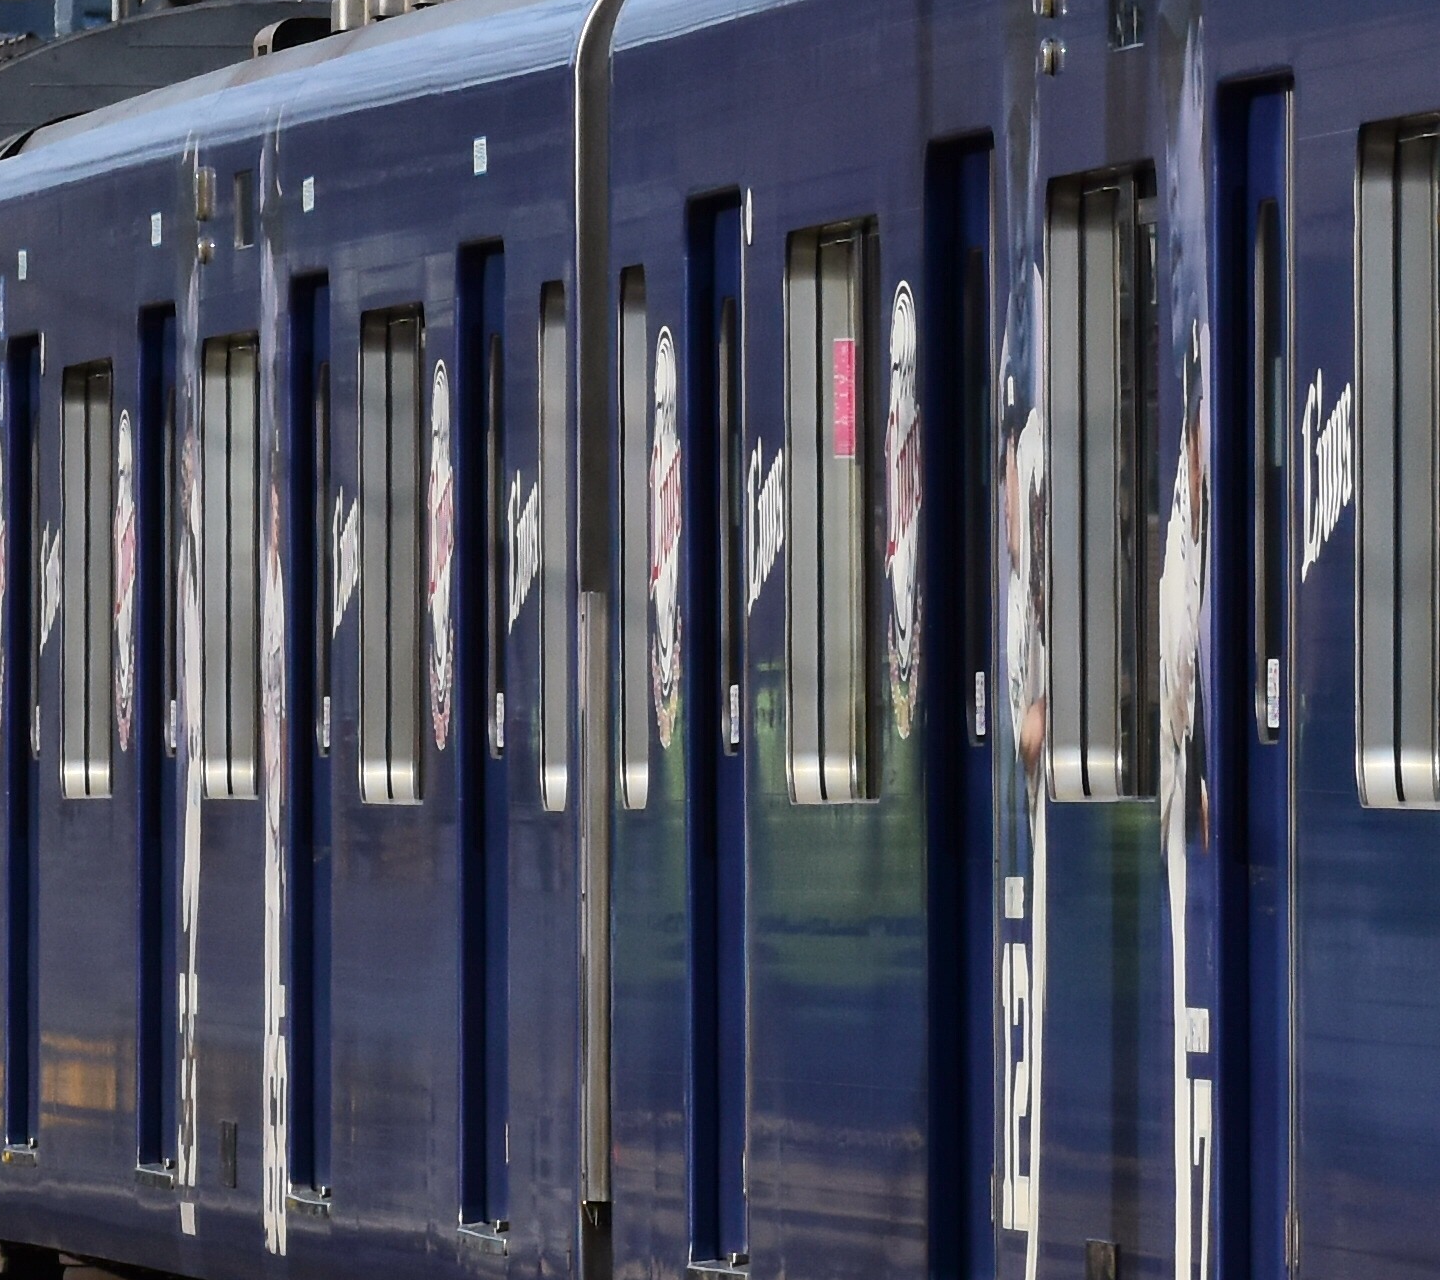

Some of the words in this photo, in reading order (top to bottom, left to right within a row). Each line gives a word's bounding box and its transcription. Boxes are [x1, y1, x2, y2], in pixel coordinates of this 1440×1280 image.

[748, 436, 784, 616] Lions
[1301, 368, 1353, 583] Lions
[1002, 943, 1030, 1231] 12
